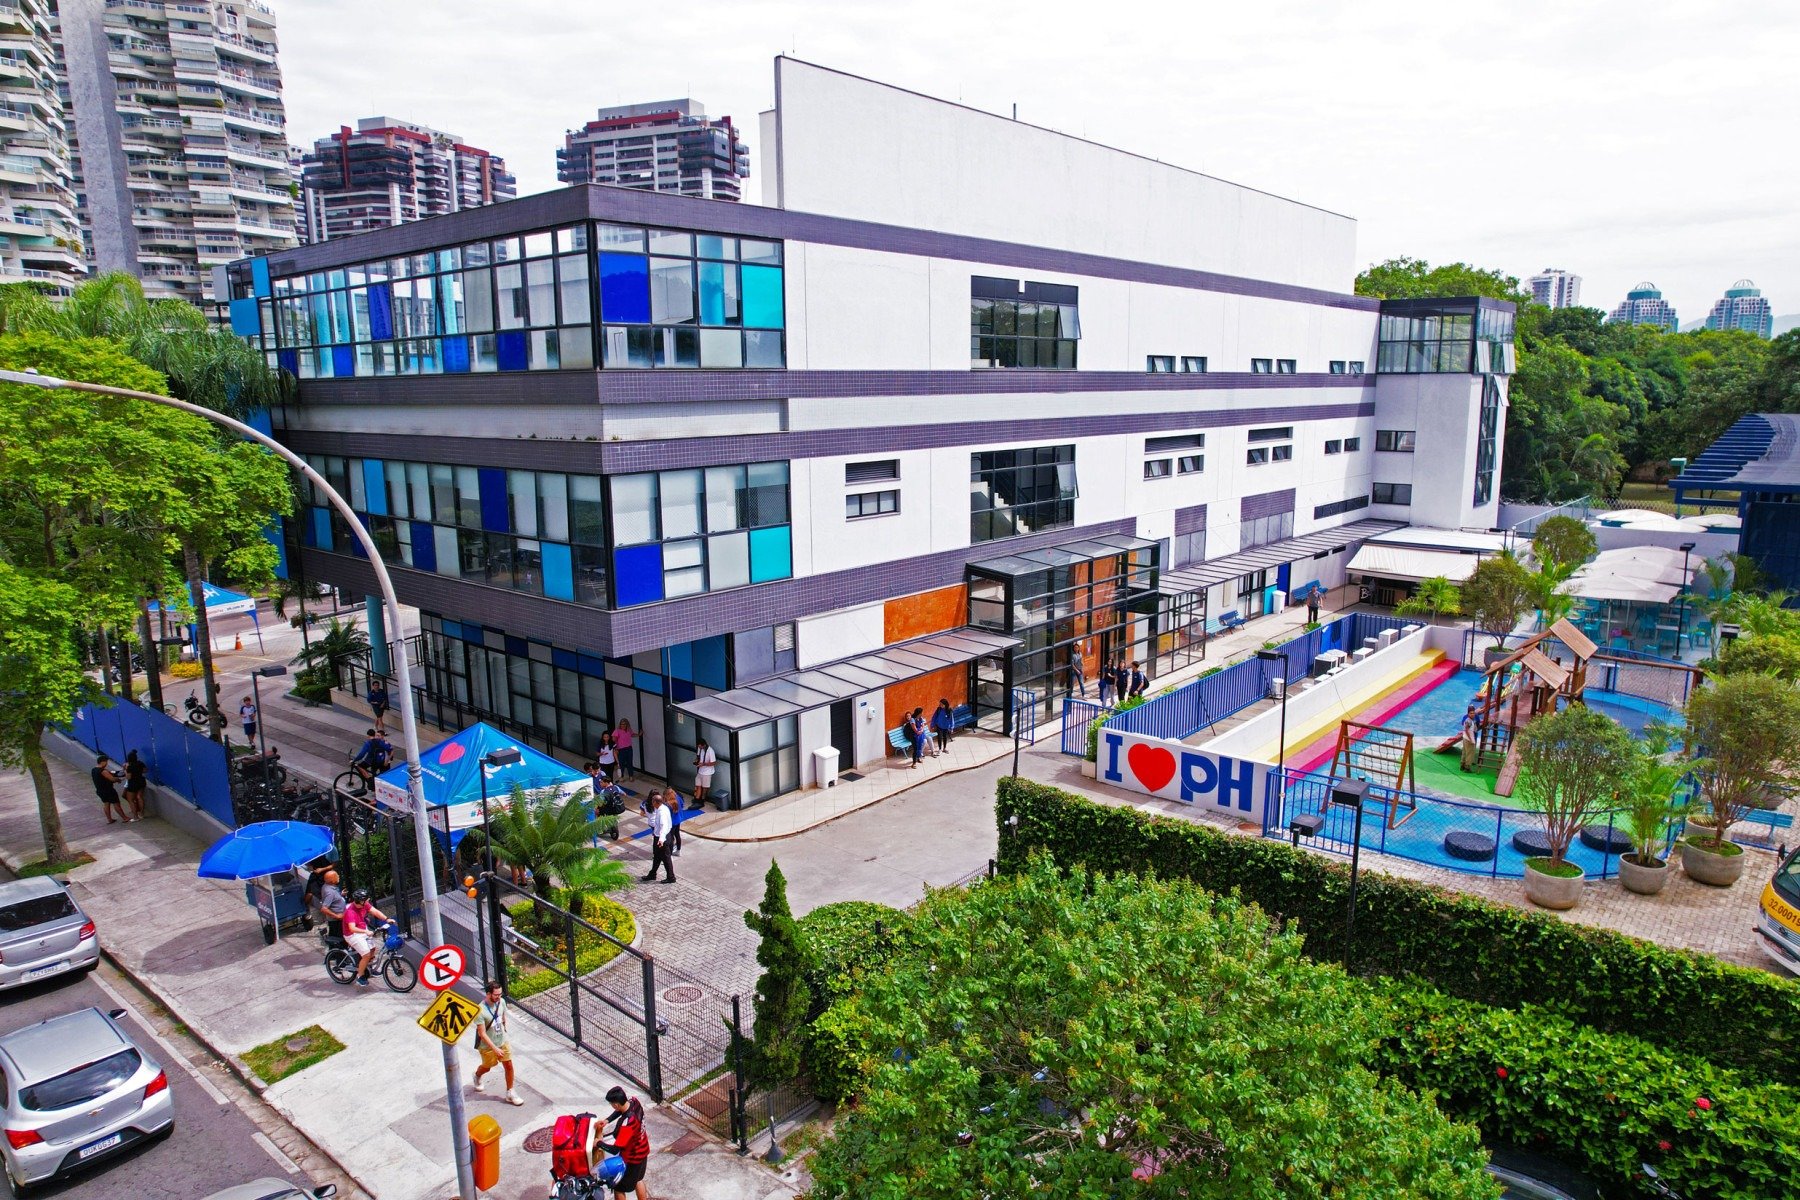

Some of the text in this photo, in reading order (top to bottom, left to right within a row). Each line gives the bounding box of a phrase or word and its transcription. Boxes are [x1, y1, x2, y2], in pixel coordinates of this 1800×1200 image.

[1105, 733, 1254, 812] I PH
[434, 953, 452, 982] E
